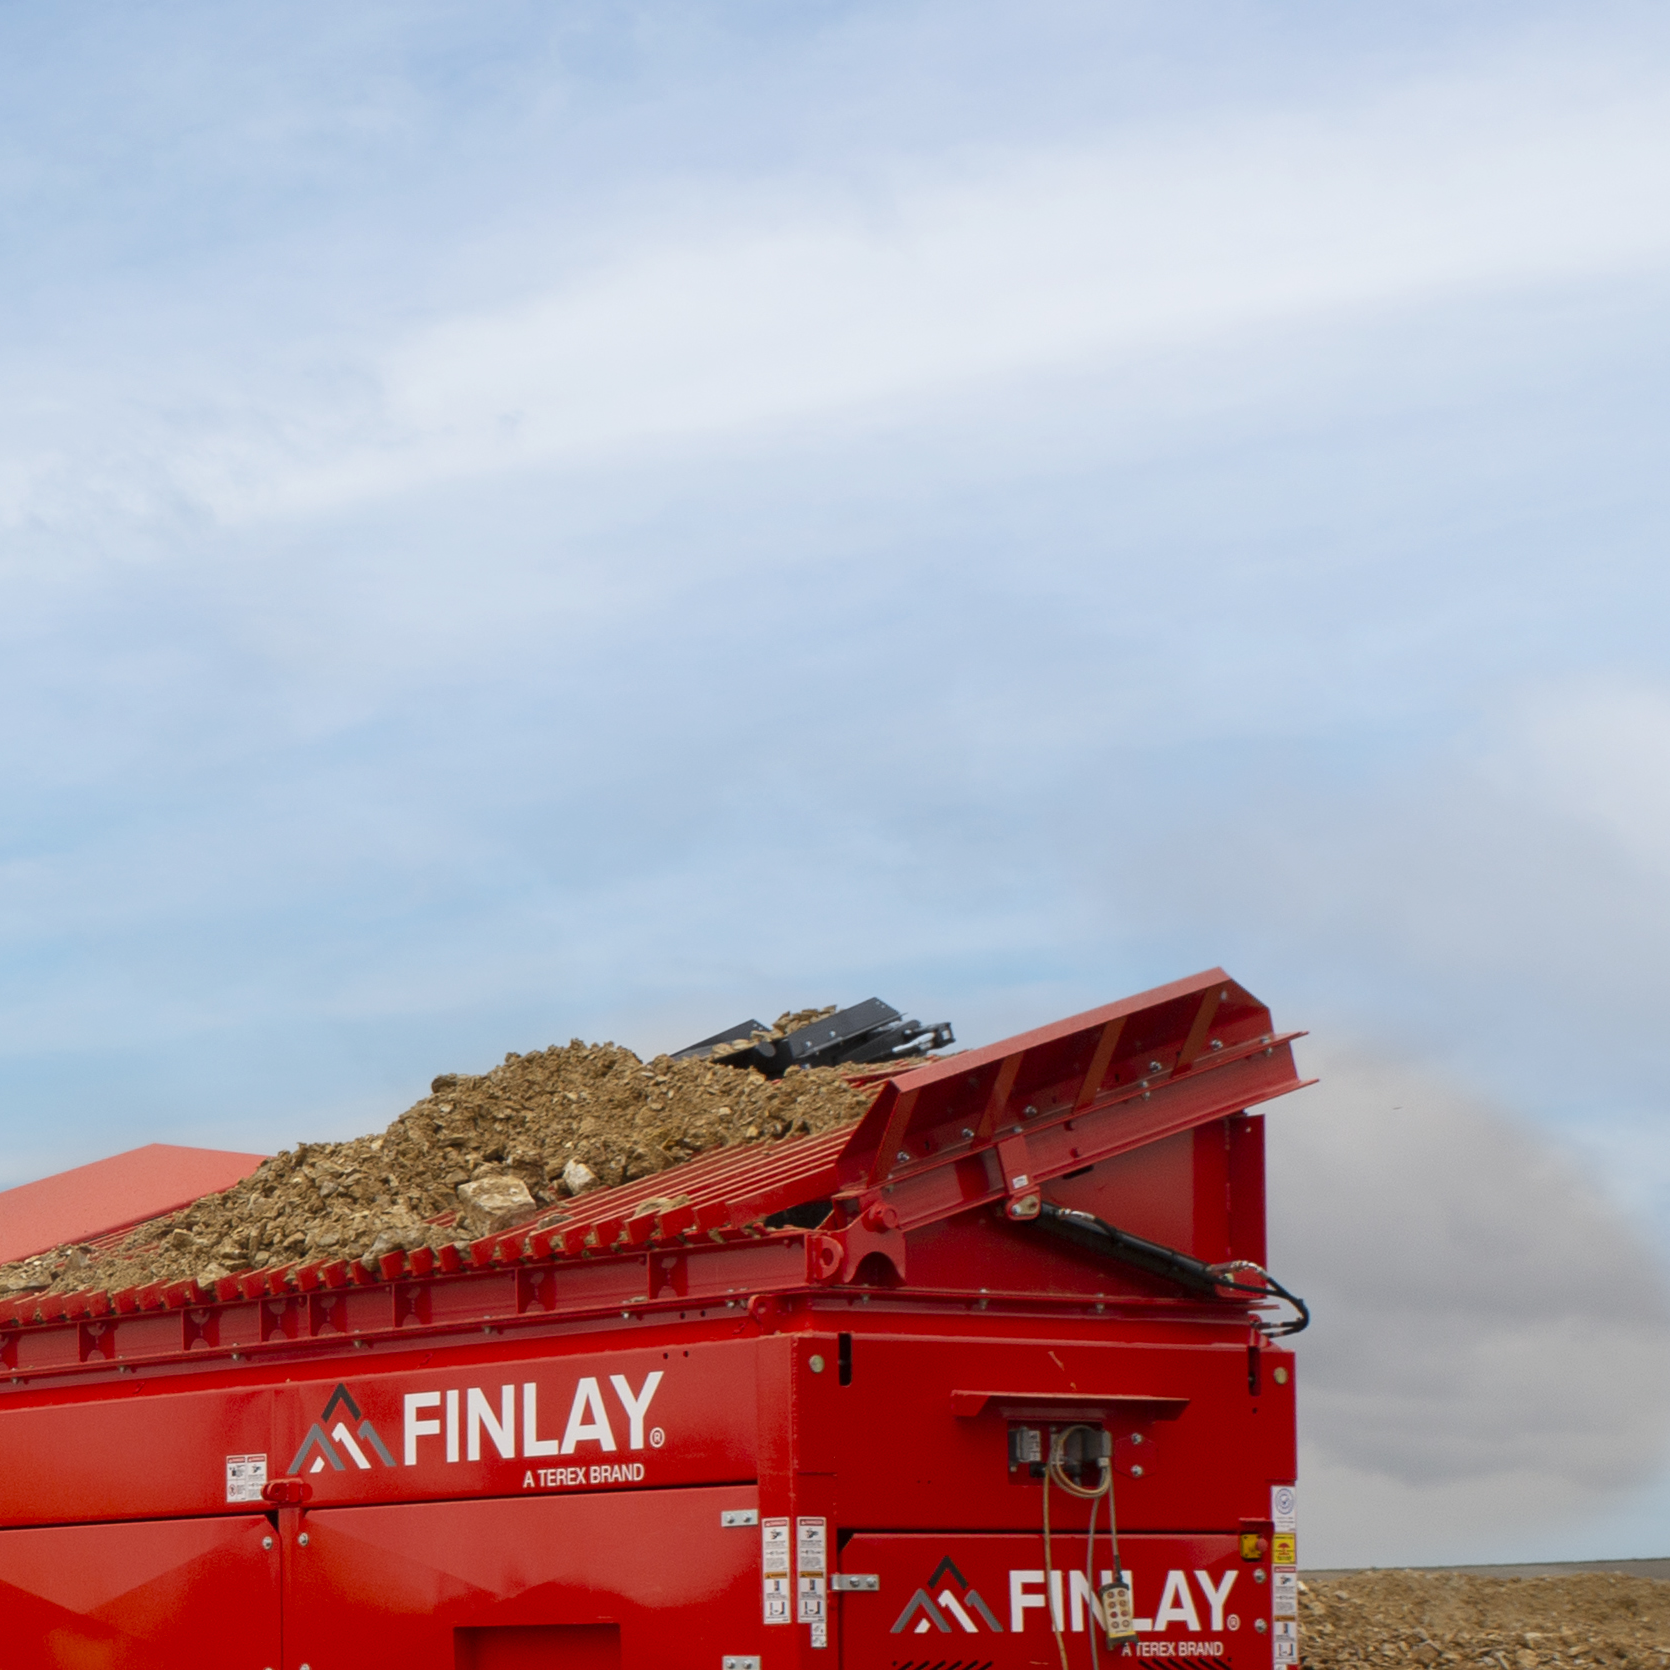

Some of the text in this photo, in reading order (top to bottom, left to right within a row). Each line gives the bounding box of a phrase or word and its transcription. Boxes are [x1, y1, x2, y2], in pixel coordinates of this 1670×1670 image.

[523, 1462, 645, 1488] A TEREX BRAND
[1121, 1641, 1224, 1657] A TEREX BRAND
